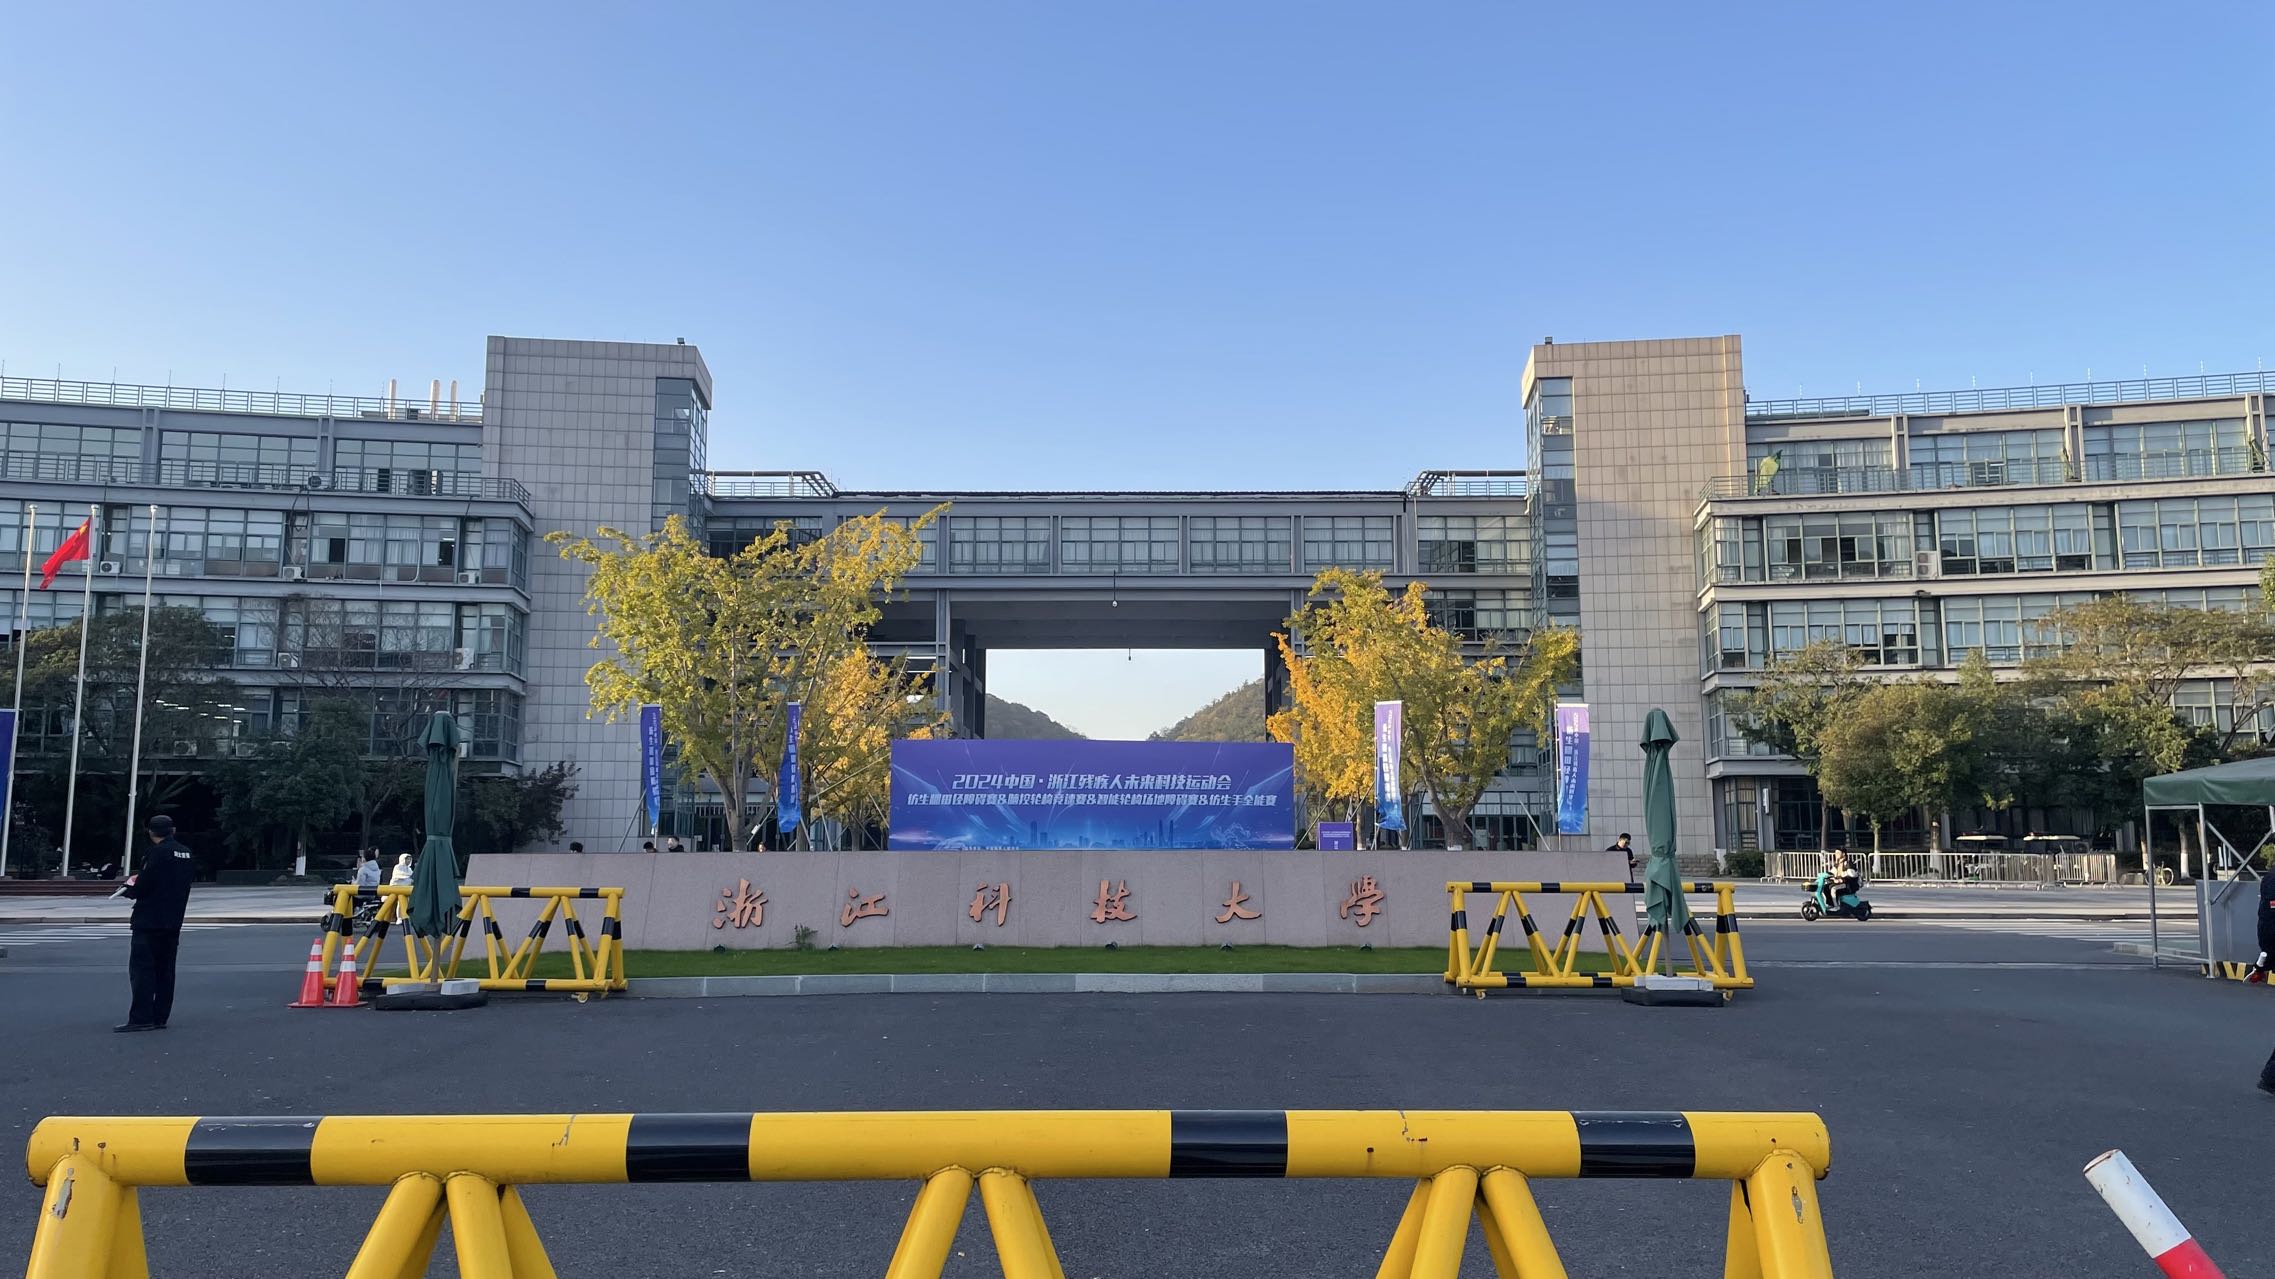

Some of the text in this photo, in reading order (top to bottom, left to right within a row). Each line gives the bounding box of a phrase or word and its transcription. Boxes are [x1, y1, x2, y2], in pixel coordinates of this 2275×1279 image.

[952, 774, 1231, 790] 2024中国·浙江残疾人未来科技运动会
[713, 873, 1385, 929] 浙江科技大学
